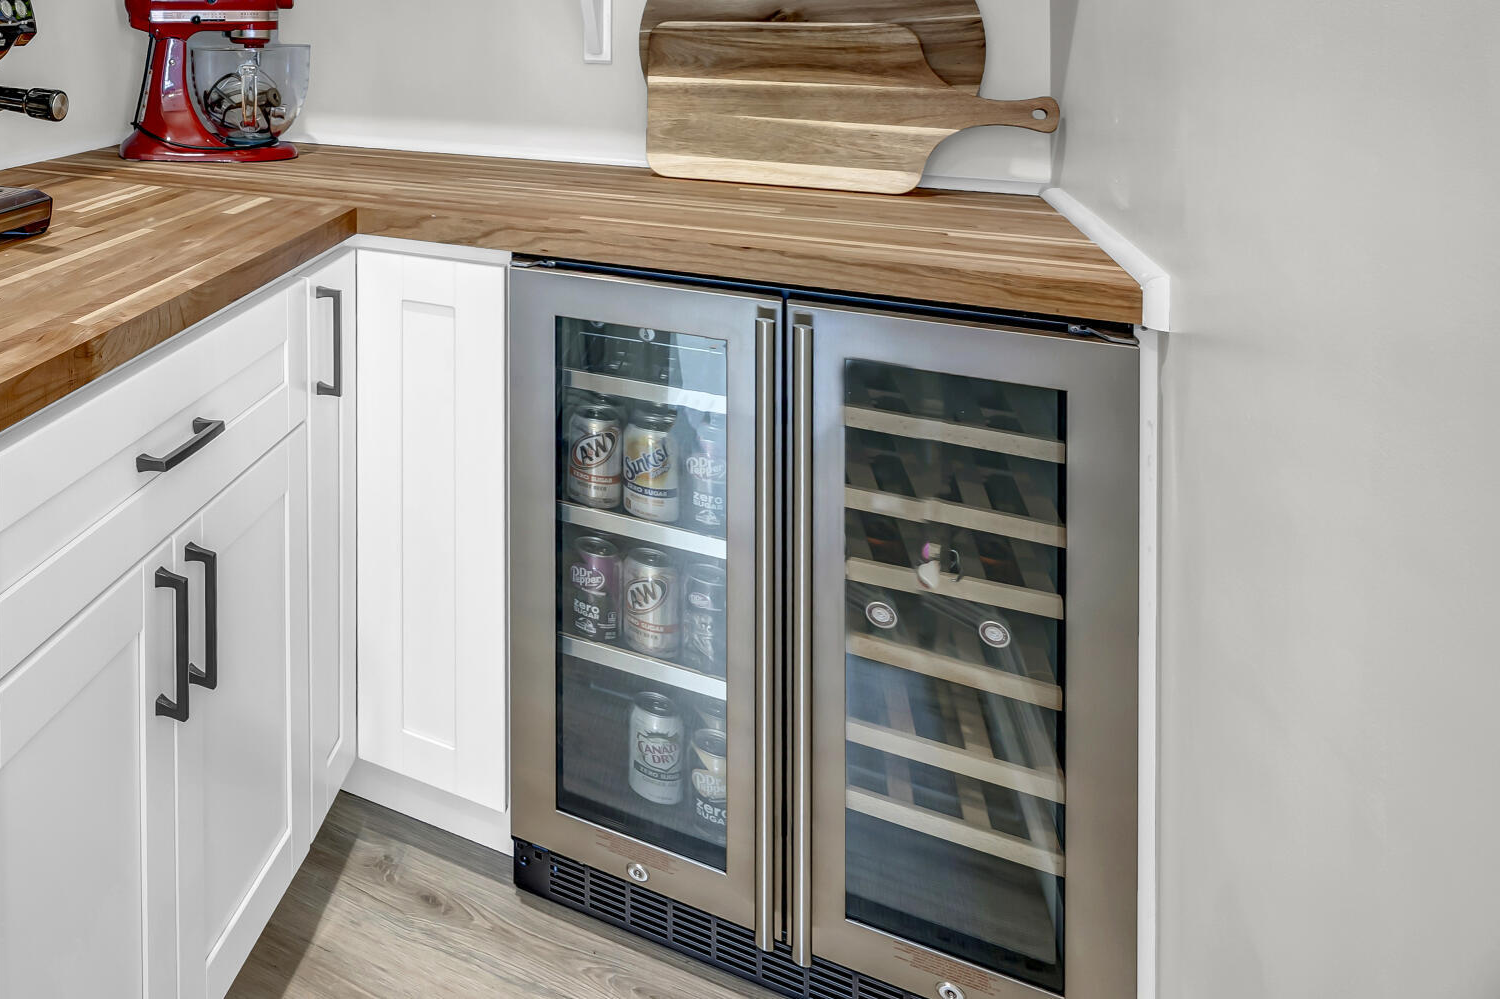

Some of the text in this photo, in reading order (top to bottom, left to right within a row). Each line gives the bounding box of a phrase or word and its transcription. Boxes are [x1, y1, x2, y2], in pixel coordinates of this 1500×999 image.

[624, 435, 670, 481] Sunkist
[590, 475, 613, 484] SUGAR
[644, 488, 668, 497] SUGAR
[693, 491, 723, 504] zero
[580, 568, 593, 578] Dr
[573, 599, 600, 613] zero
[574, 607, 600, 620] SUGAR
[640, 622, 665, 633] SUGAR
[638, 740, 679, 755] CANAD
[651, 754, 676, 764] DRY
[697, 806, 726, 826] SUGA
